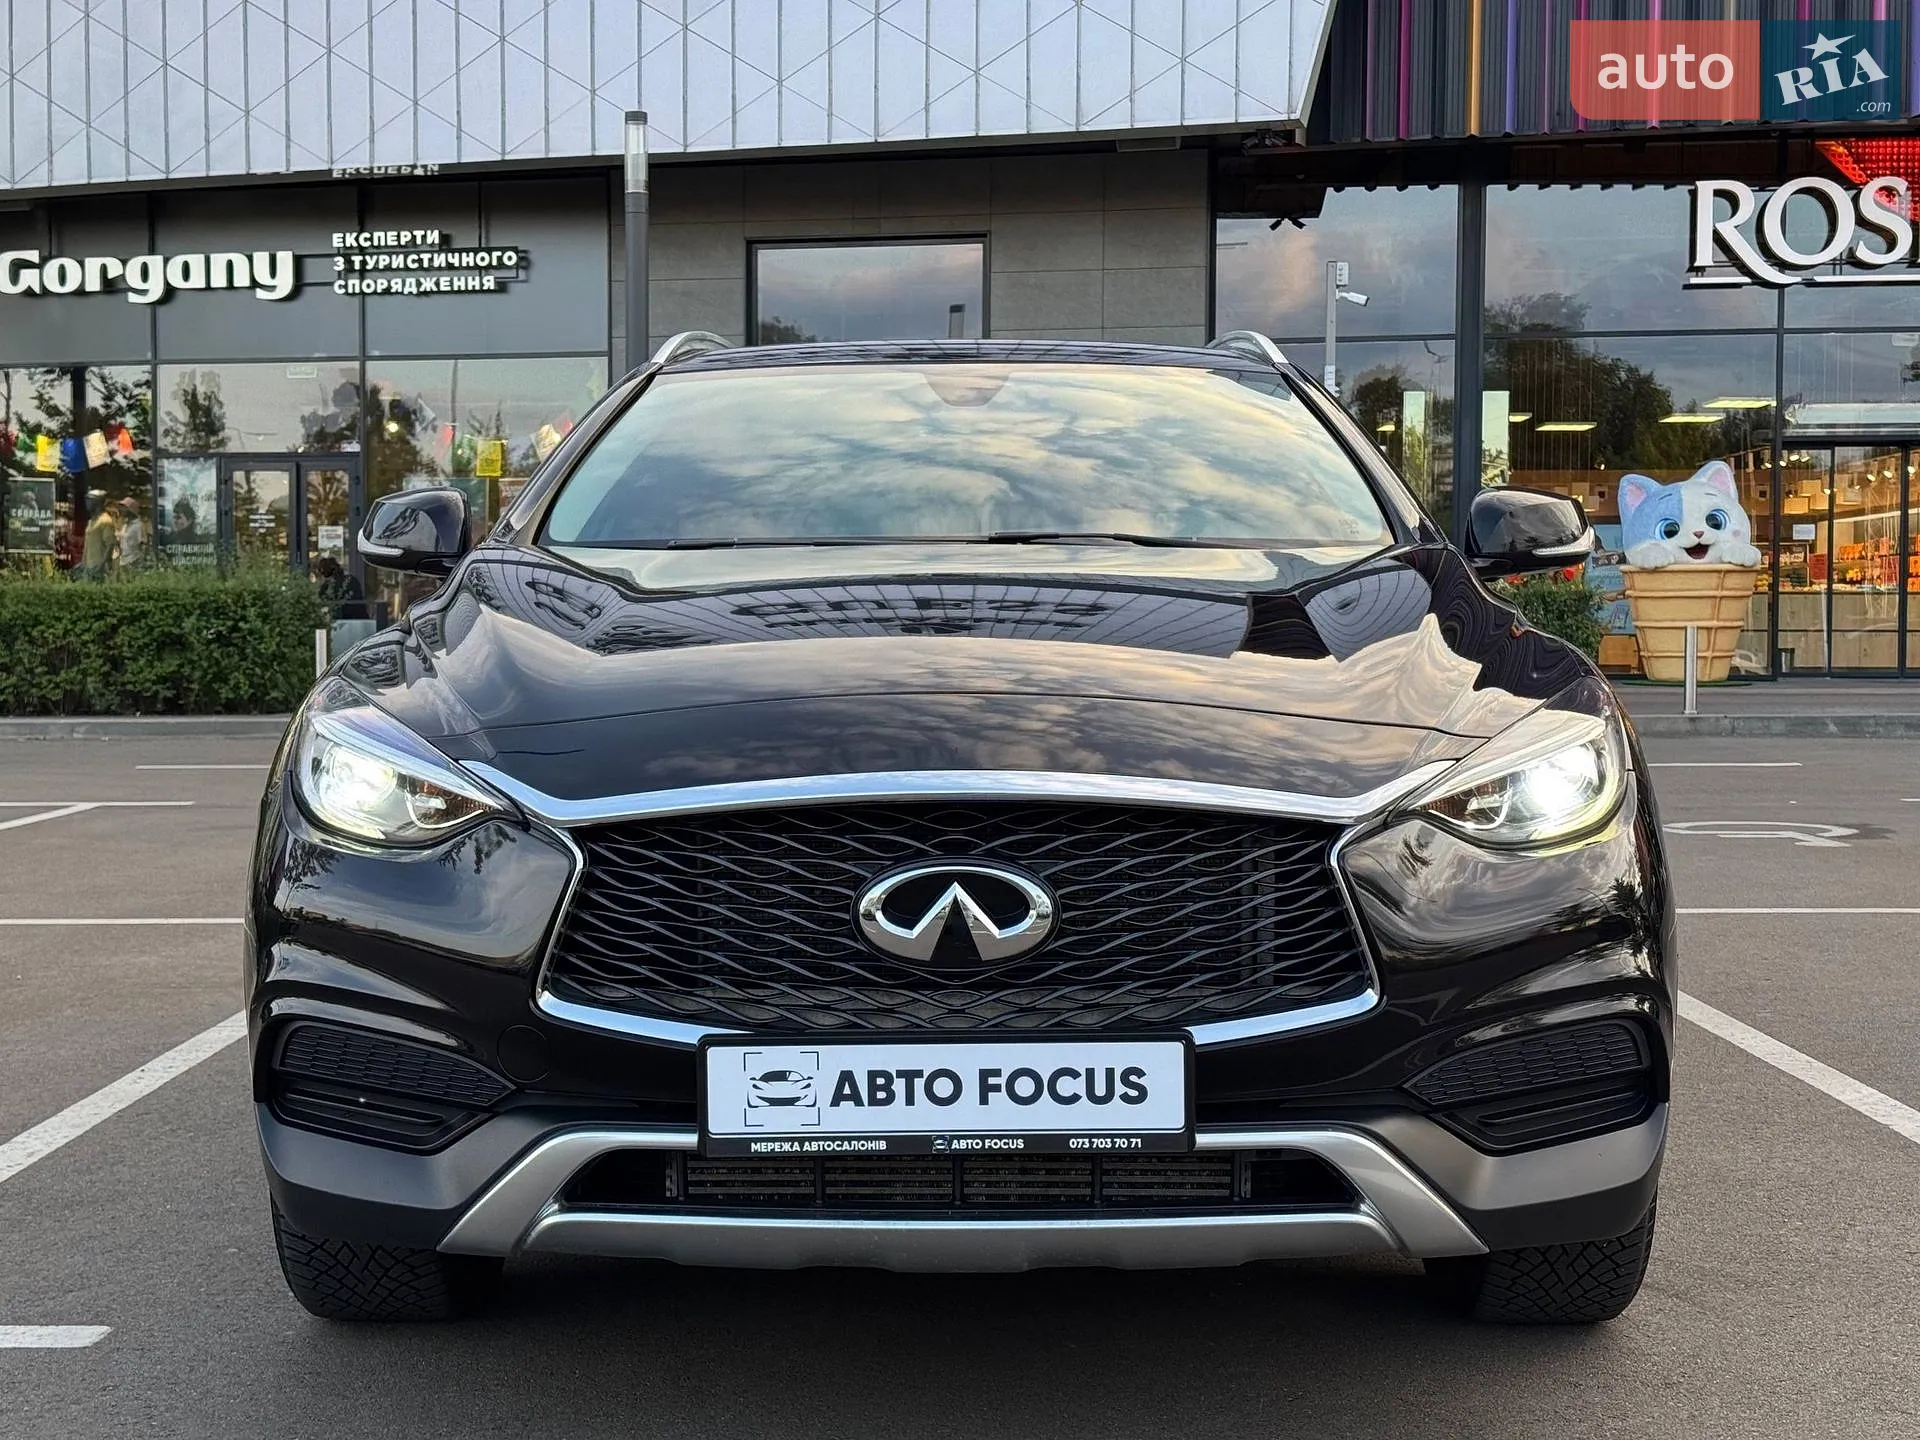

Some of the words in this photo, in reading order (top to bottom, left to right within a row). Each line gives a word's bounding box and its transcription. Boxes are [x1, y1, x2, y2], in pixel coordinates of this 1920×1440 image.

[332, 230, 440, 248] ЕКСПЕРТИ
[1694, 176, 1920, 284] ROS
[352, 251, 518, 271] ТУРИСТИЧНОГО
[0, 250, 294, 303] Gorgany
[333, 275, 496, 295] СПОРЯДЖЕННЯ
[829, 1068, 963, 1107] АВТО
[978, 1066, 1148, 1106] FOCUS
[751, 1142, 800, 1152] МЕРЕЖА
[803, 1140, 887, 1152] АВТОСАЛОНІВ
[951, 1139, 982, 1149] АВТО
[985, 1139, 1024, 1149] FOCUS
[1069, 1138, 1089, 1149] 073
[1092, 1138, 1111, 1149] 703
[1114, 1138, 1128, 1149] 70
[1130, 1138, 1142, 1149] 71
